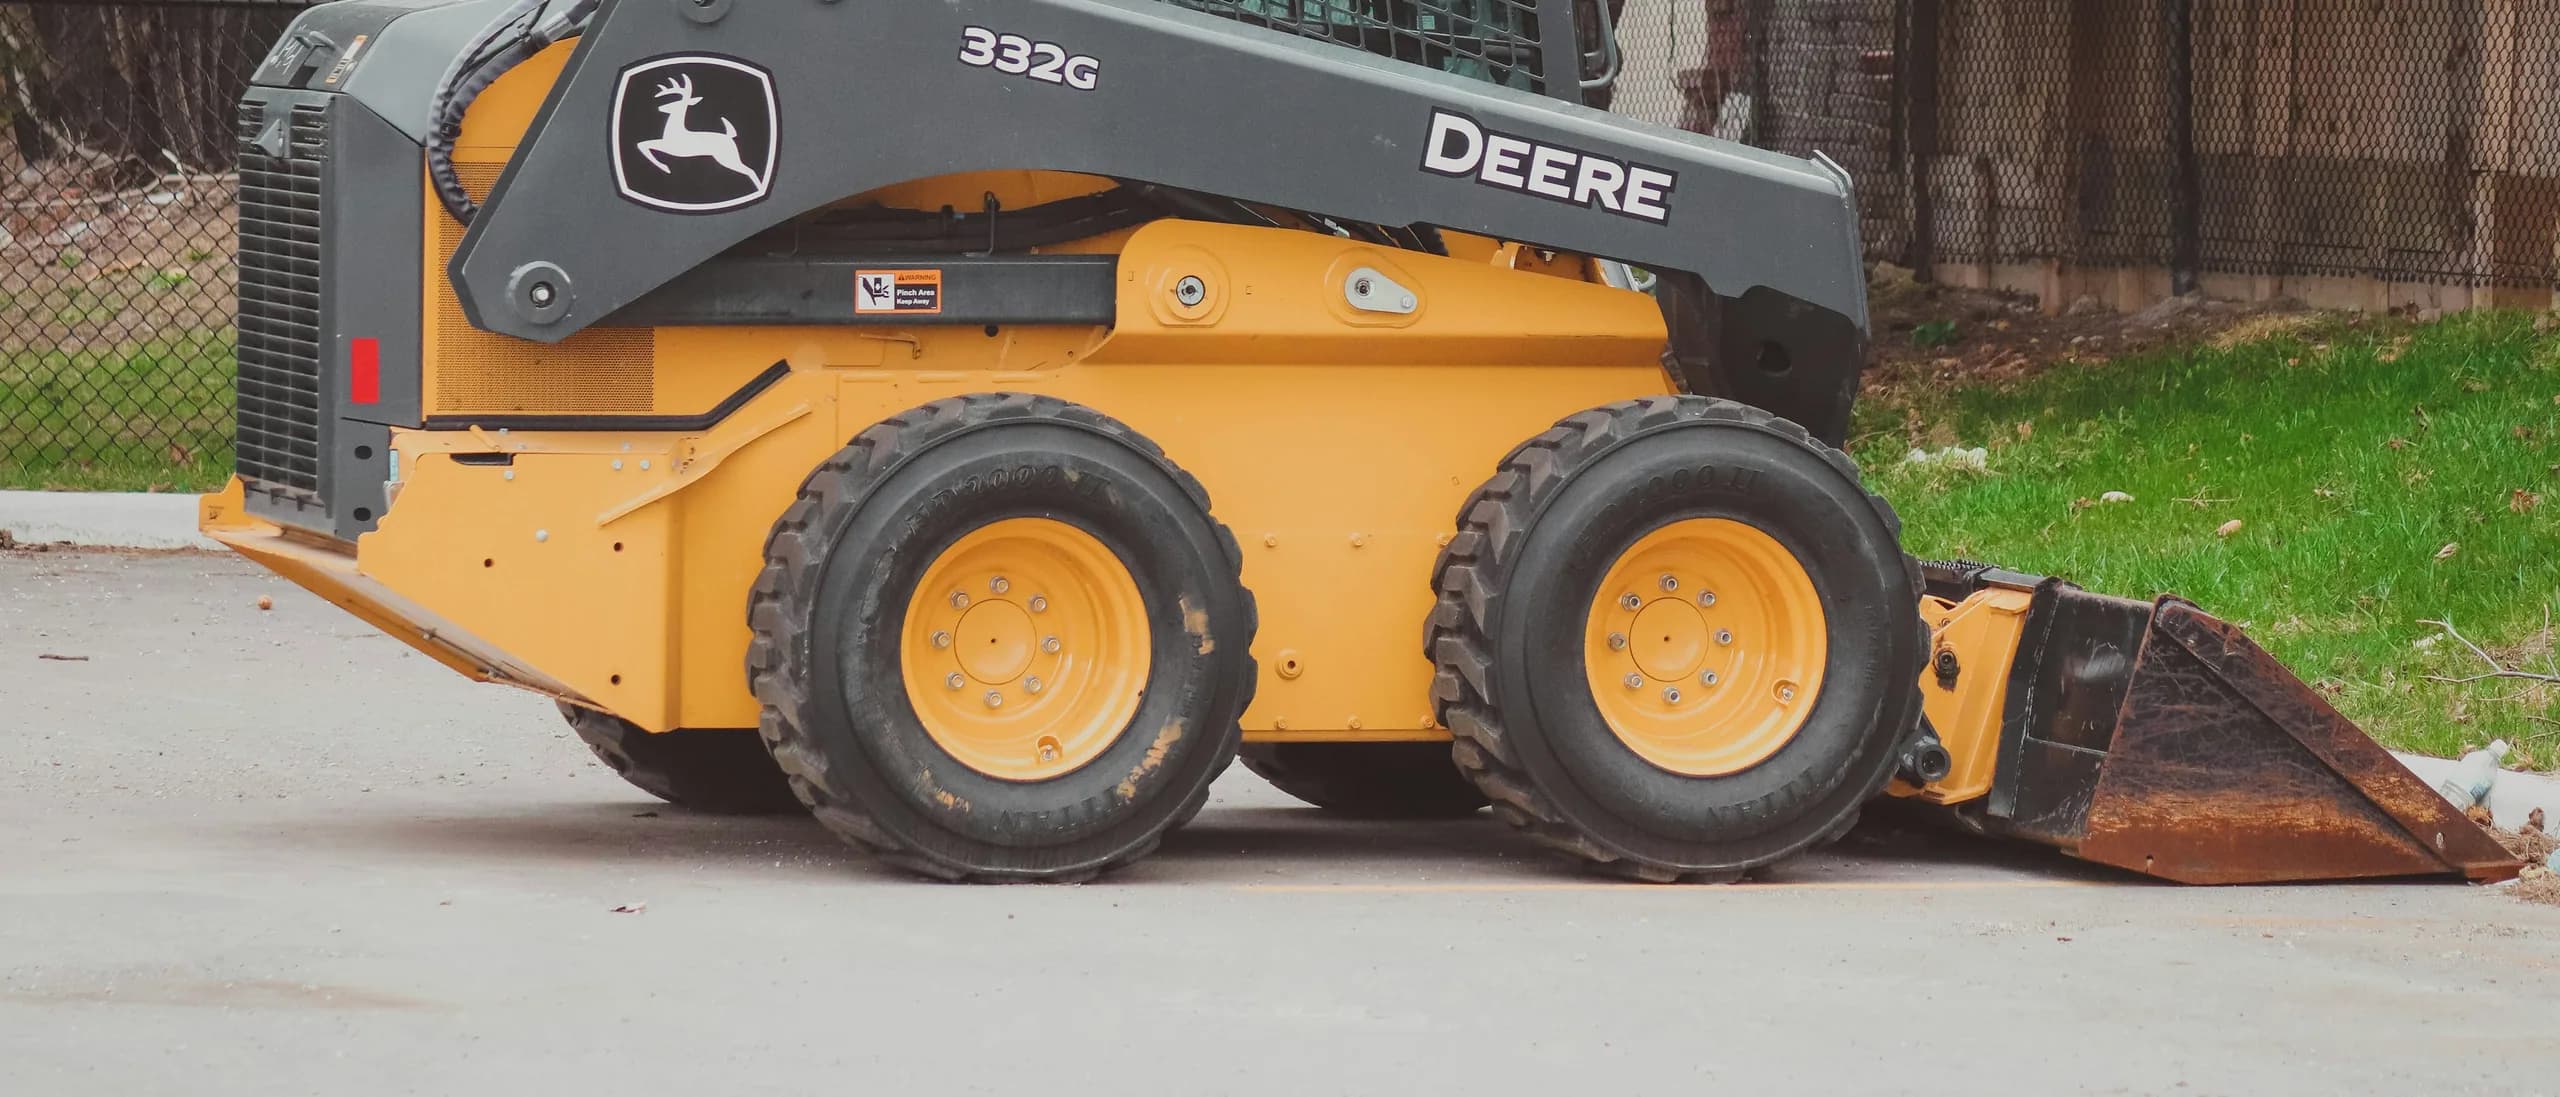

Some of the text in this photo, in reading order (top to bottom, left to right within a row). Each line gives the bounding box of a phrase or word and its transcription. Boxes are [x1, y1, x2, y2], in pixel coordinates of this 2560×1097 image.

[959, 27, 1100, 90] 332G
[1424, 111, 1673, 221] DEERE
[896, 288, 936, 297] Pinch Area
[896, 298, 930, 306] Keep Away
